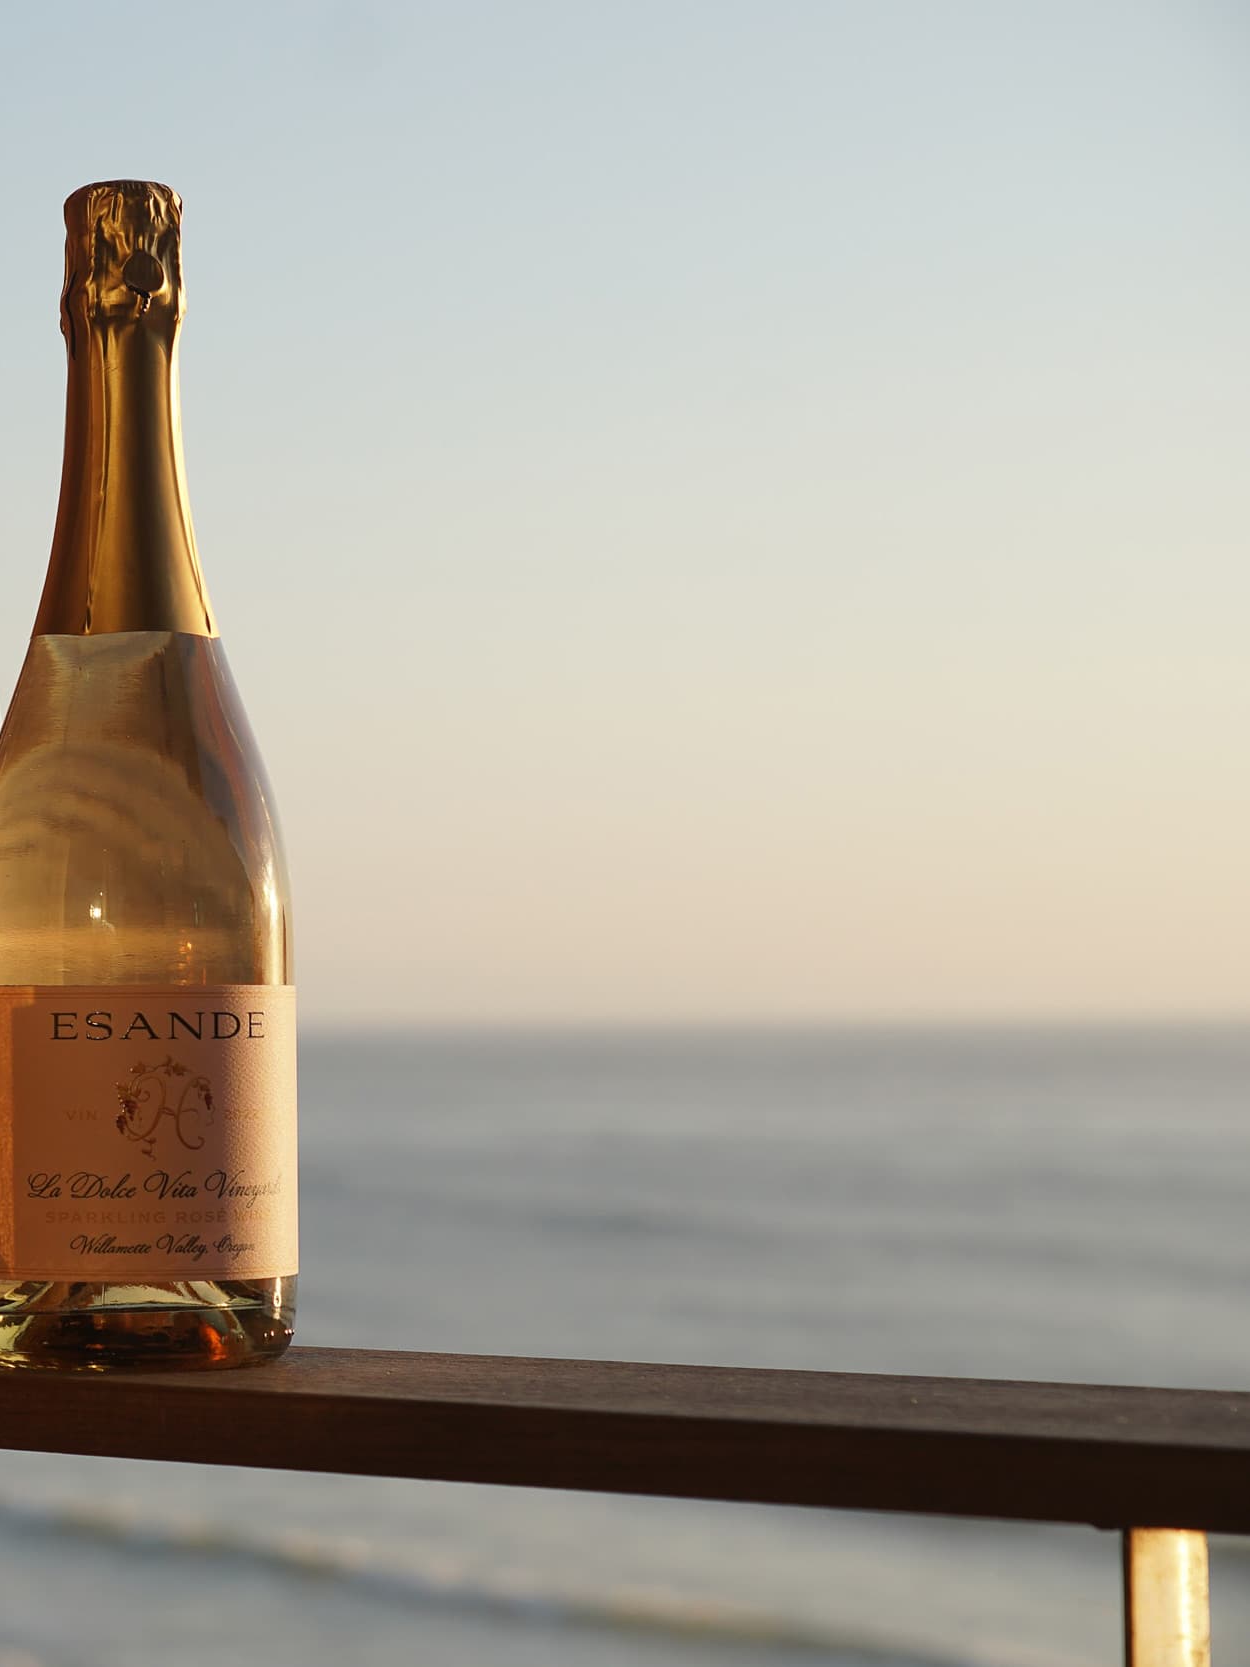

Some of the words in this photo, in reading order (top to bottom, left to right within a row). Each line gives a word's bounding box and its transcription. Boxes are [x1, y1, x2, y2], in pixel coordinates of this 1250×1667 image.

[49, 1010, 265, 1041] ESANDE
[64, 1109, 98, 1121] VIN
[27, 1172, 63, 1199] La
[66, 1171, 137, 1199] Dolce
[142, 1169, 199, 1200] Vita
[45, 1210, 167, 1224] SPARKLING
[175, 1207, 228, 1224] ROSÉ
[69, 1233, 152, 1256] Willamette
[212, 1233, 256, 1261] Oregon
